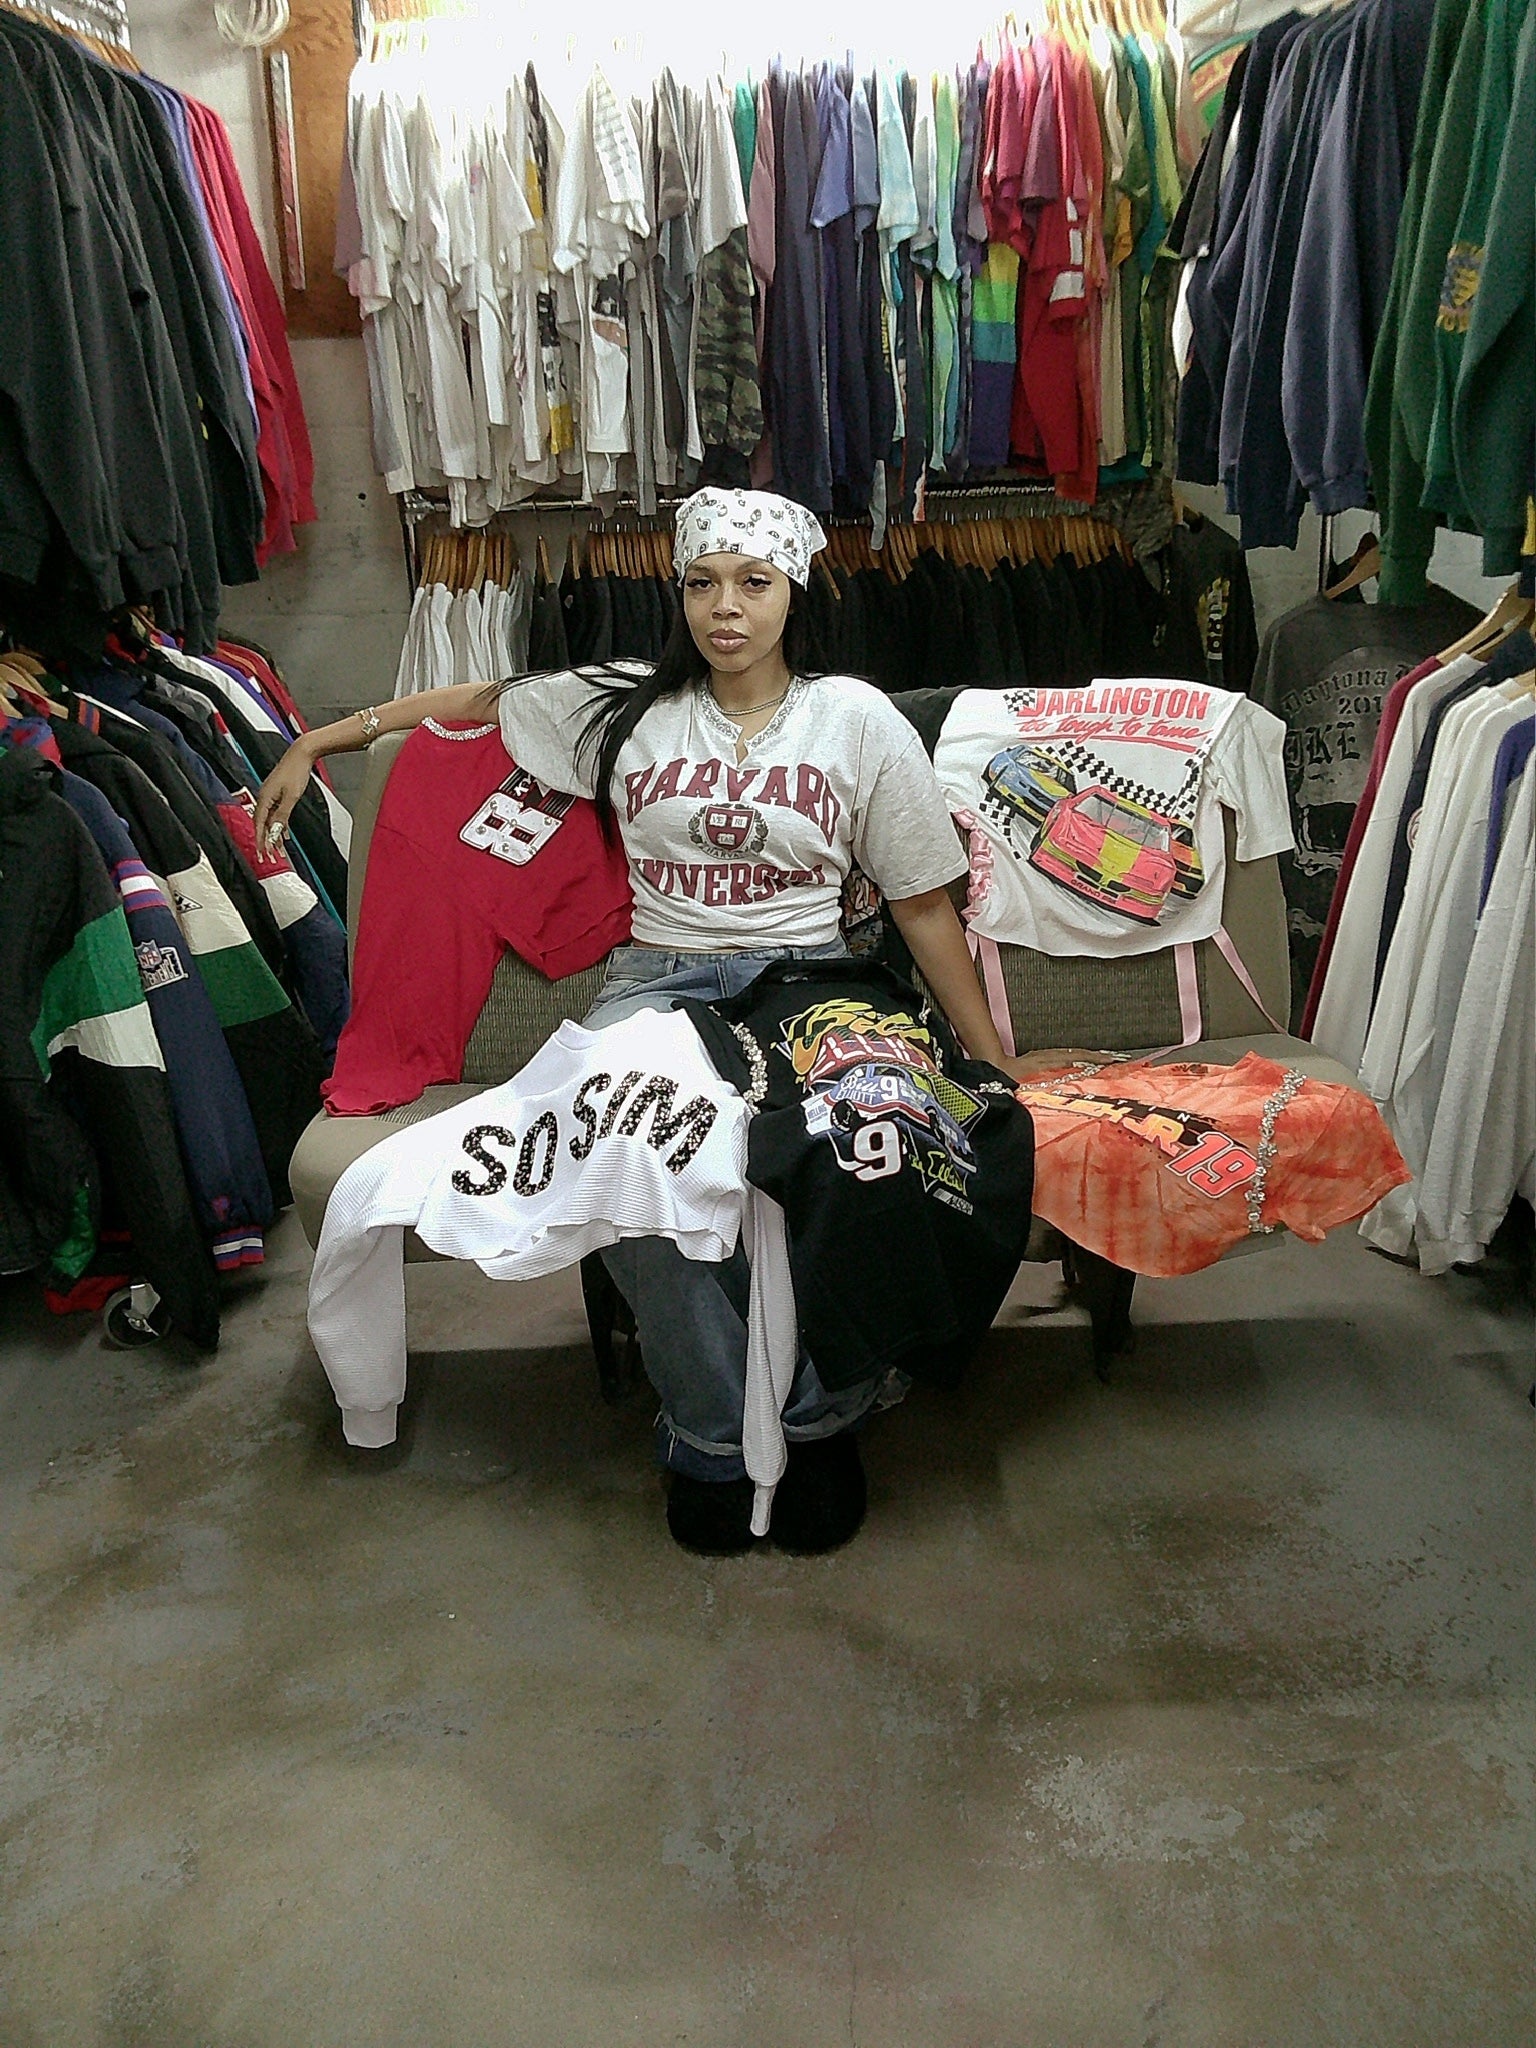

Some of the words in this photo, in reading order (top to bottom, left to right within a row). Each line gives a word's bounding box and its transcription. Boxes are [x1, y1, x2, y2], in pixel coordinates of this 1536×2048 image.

[1013, 718, 1051, 733] too
[1057, 715, 1114, 744] tough
[1117, 717, 1145, 736] to
[1147, 719, 1213, 740] tame
[625, 757, 841, 848] HARVARD
[835, 1087, 877, 1105] ELLIOTT
[840, 1074, 881, 1094] Bill
[880, 1075, 899, 1101] 9
[853, 1119, 902, 1182] 9
[1122, 1113, 1185, 1158] JR
[1164, 1131, 1259, 1199] 19
